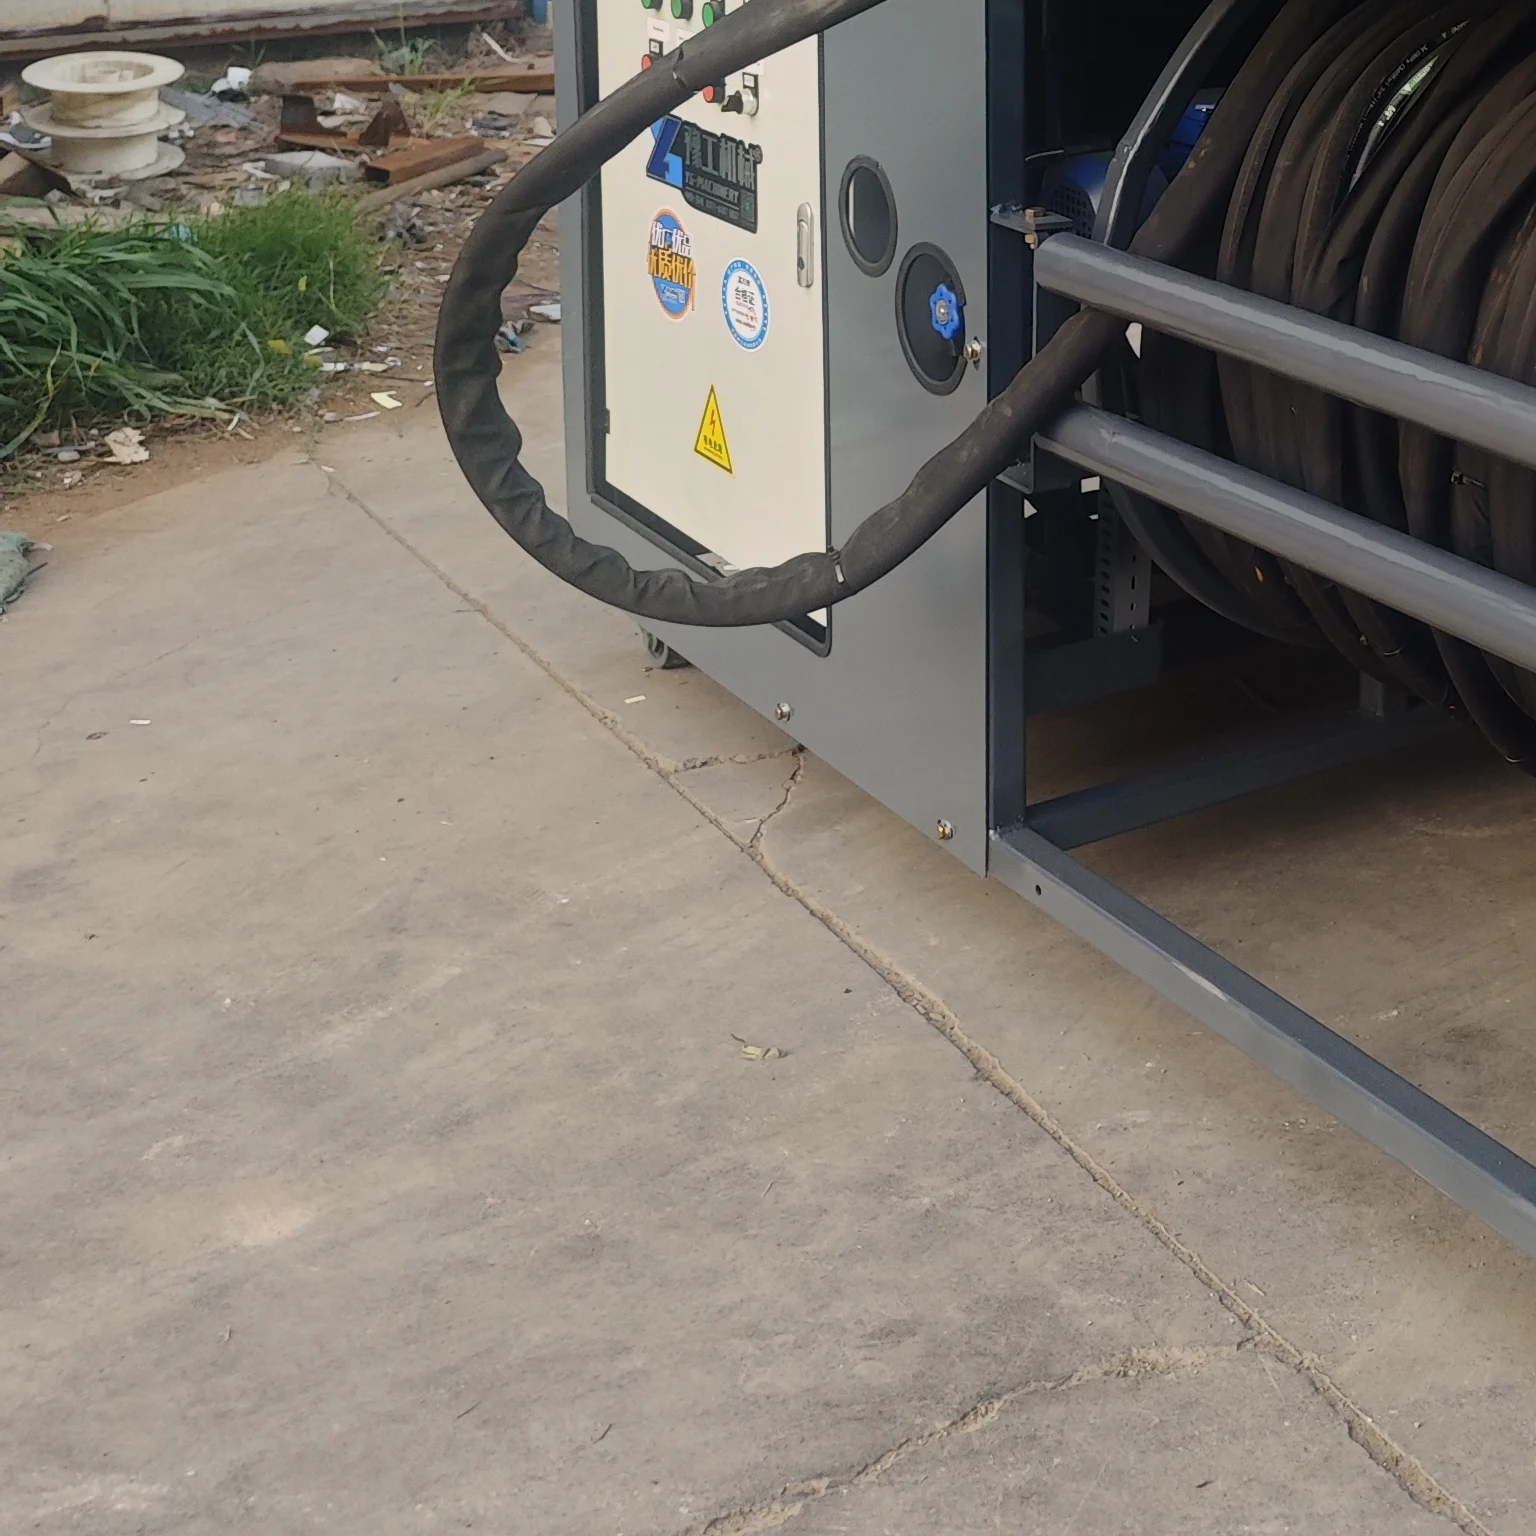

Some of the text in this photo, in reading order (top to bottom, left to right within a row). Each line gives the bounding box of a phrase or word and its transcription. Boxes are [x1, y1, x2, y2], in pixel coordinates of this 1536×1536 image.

[651, 220, 694, 257] 优厂优品
[648, 248, 697, 310] 优质优价
